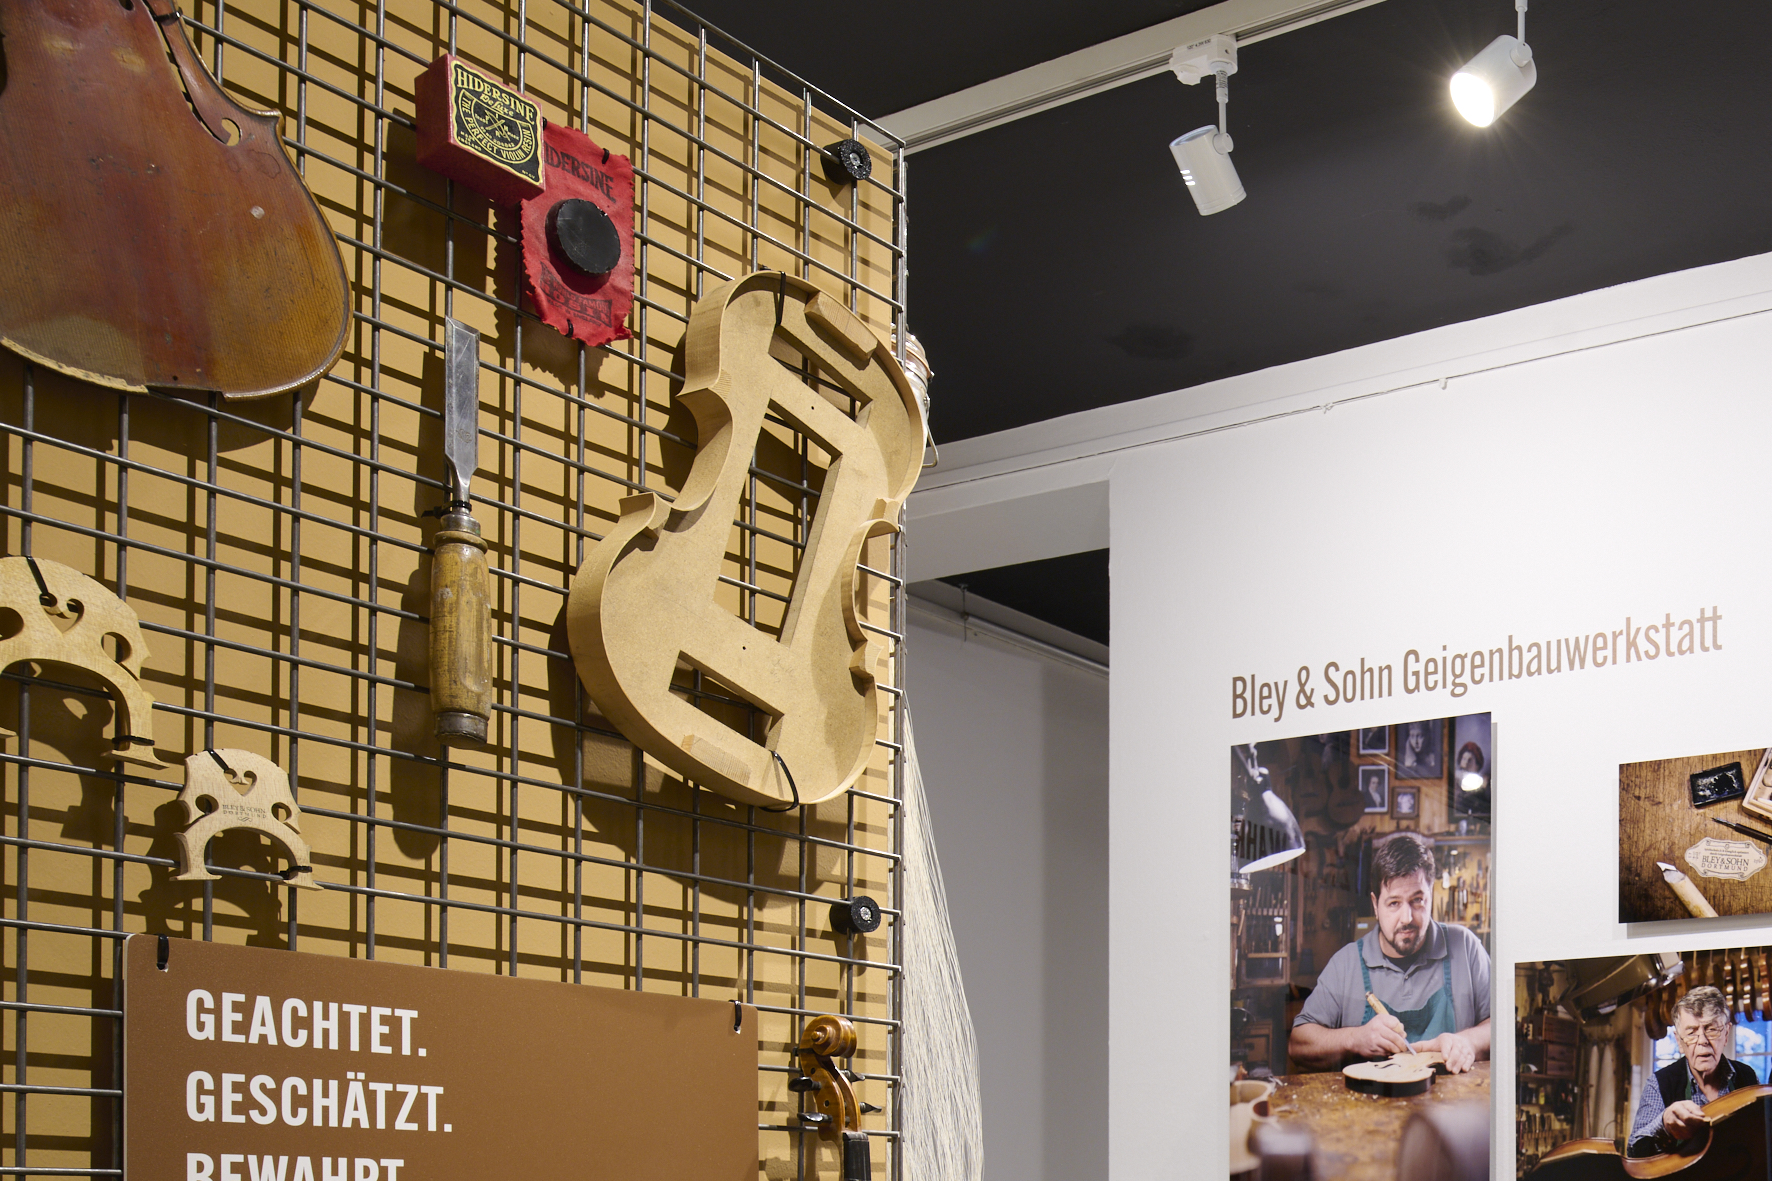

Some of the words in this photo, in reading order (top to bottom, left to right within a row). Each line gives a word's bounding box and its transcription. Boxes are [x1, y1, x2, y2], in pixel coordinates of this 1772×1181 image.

[456, 68, 535, 125] HIDERSINE
[461, 97, 471, 114] THE
[465, 117, 498, 154] PERFECT
[500, 149, 526, 161] VIOLIN
[521, 128, 532, 154] RESIN
[544, 141, 616, 204] IDERSINE
[1231, 673, 1288, 723] Bley
[1295, 665, 1315, 710] &
[1323, 656, 1394, 706] Sohn
[1403, 604, 1723, 698] Geigenbauwerkstatt
[1701, 862, 1749, 872] DORTMUND
[185, 988, 427, 1058] GEACHTET.
[185, 1070, 453, 1133] GESCHÄTZT.
